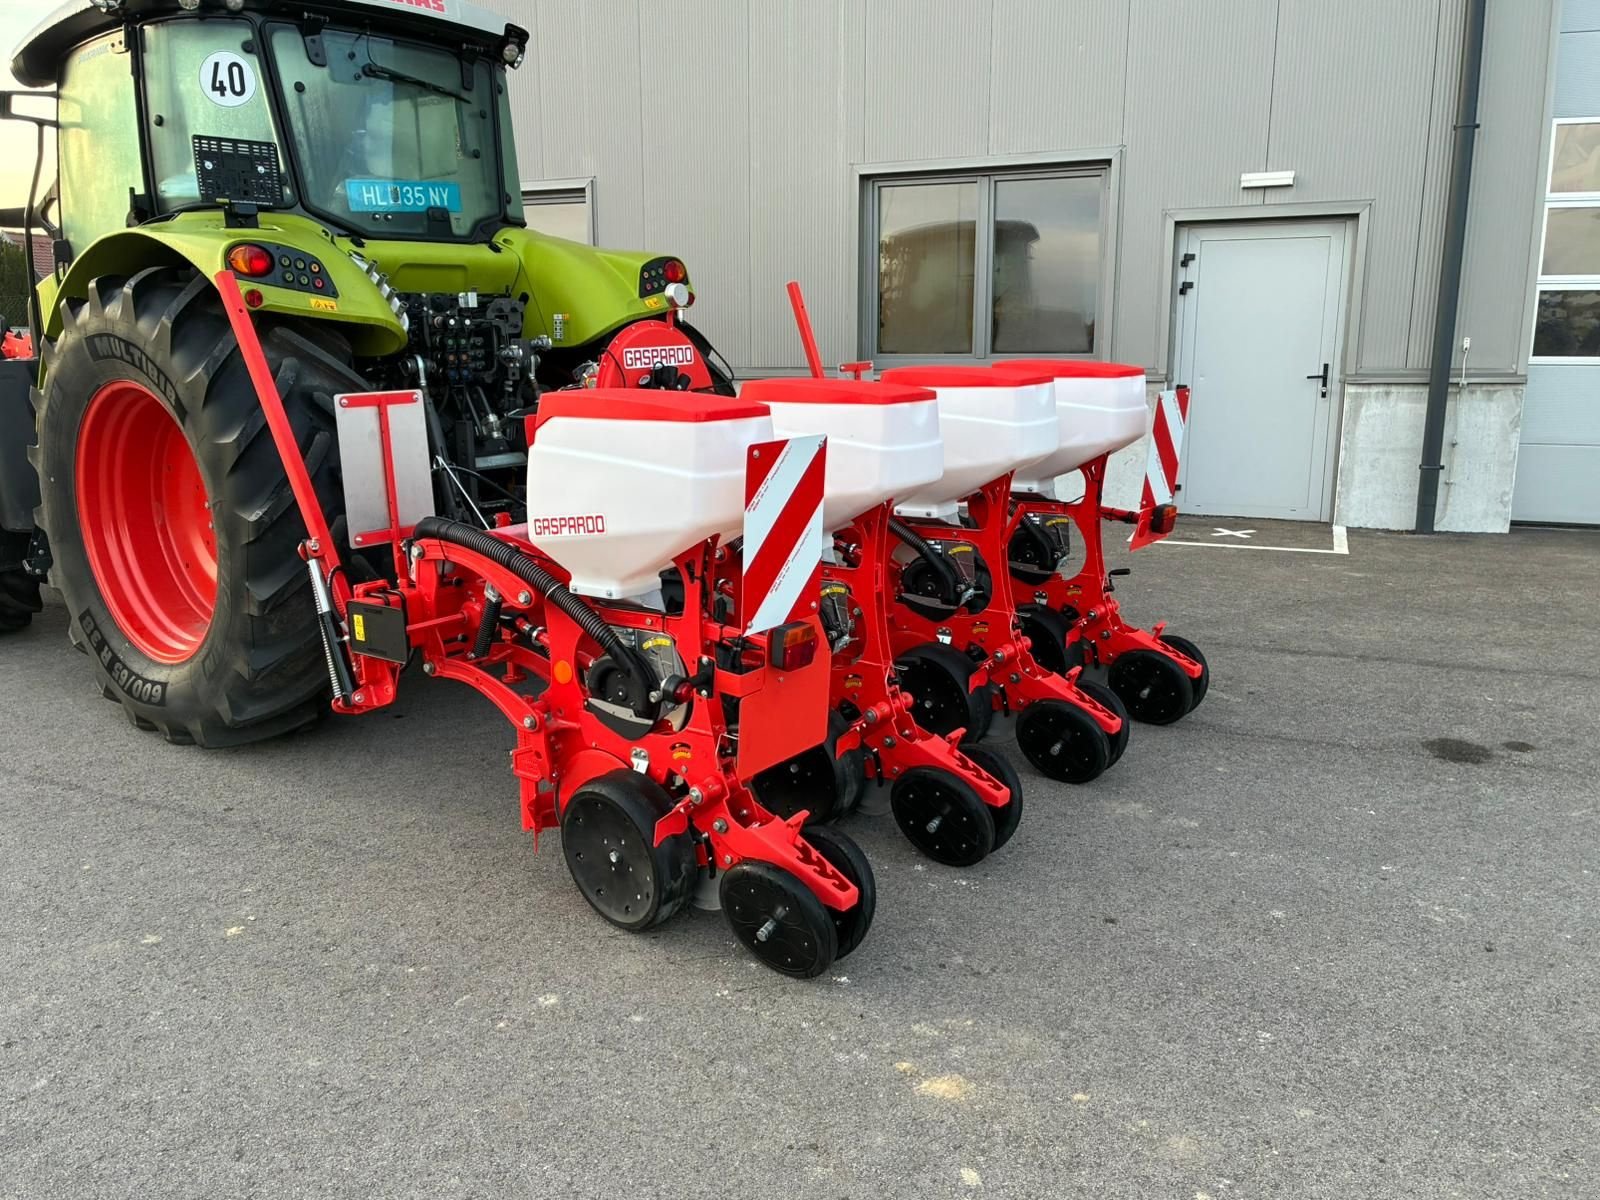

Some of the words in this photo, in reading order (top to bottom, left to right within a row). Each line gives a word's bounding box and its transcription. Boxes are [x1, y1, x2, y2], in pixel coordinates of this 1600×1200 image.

[211, 61, 246, 97] 40
[362, 185, 388, 206] HL
[403, 185, 425, 206] 35
[429, 187, 449, 206] NY
[625, 347, 693, 367] GASPARDO
[94, 336, 177, 407] MULTIBIB
[534, 515, 605, 535] GASPARDO
[111, 662, 162, 703] 600/65
